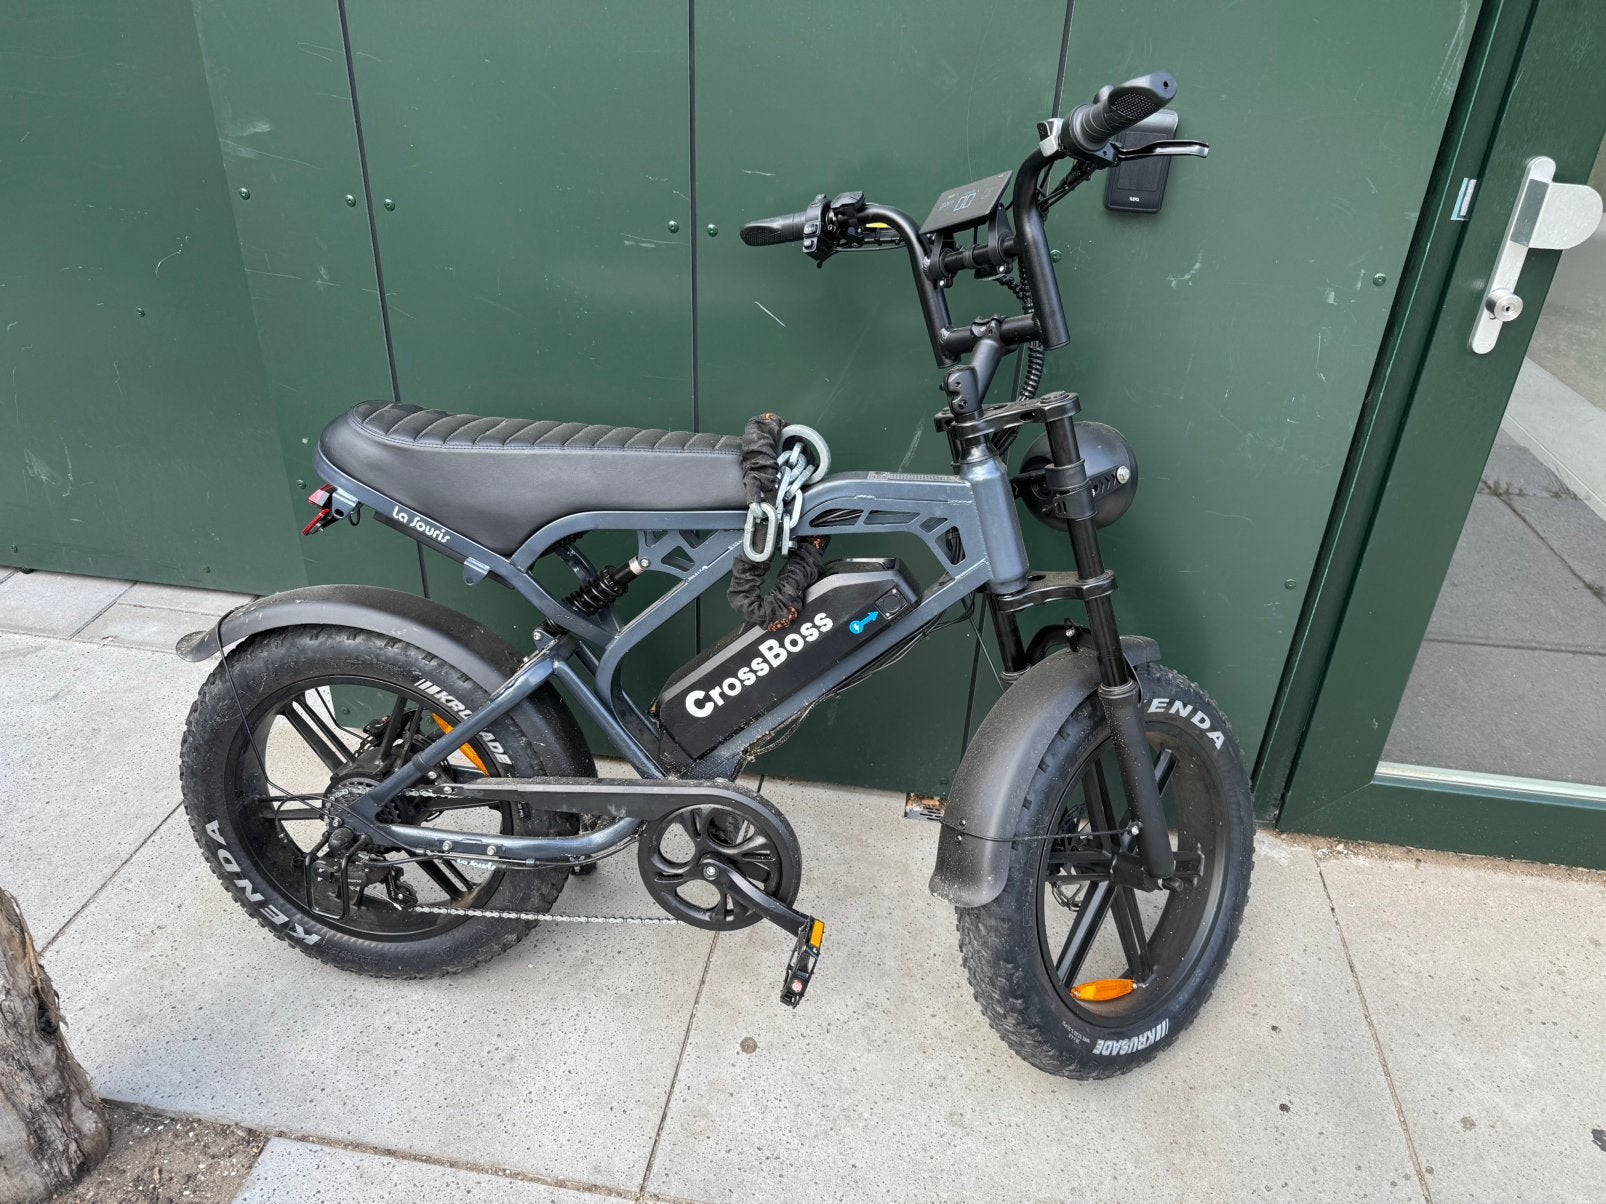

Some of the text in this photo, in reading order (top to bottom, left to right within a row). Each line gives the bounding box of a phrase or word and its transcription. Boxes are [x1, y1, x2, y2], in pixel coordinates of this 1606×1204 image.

[392, 505, 451, 543] La Souris
[685, 610, 834, 718] CrossBoss
[1143, 697, 1225, 750] ENDA
[205, 819, 322, 946] KENDA
[1091, 1027, 1157, 1057] KRUSADE
